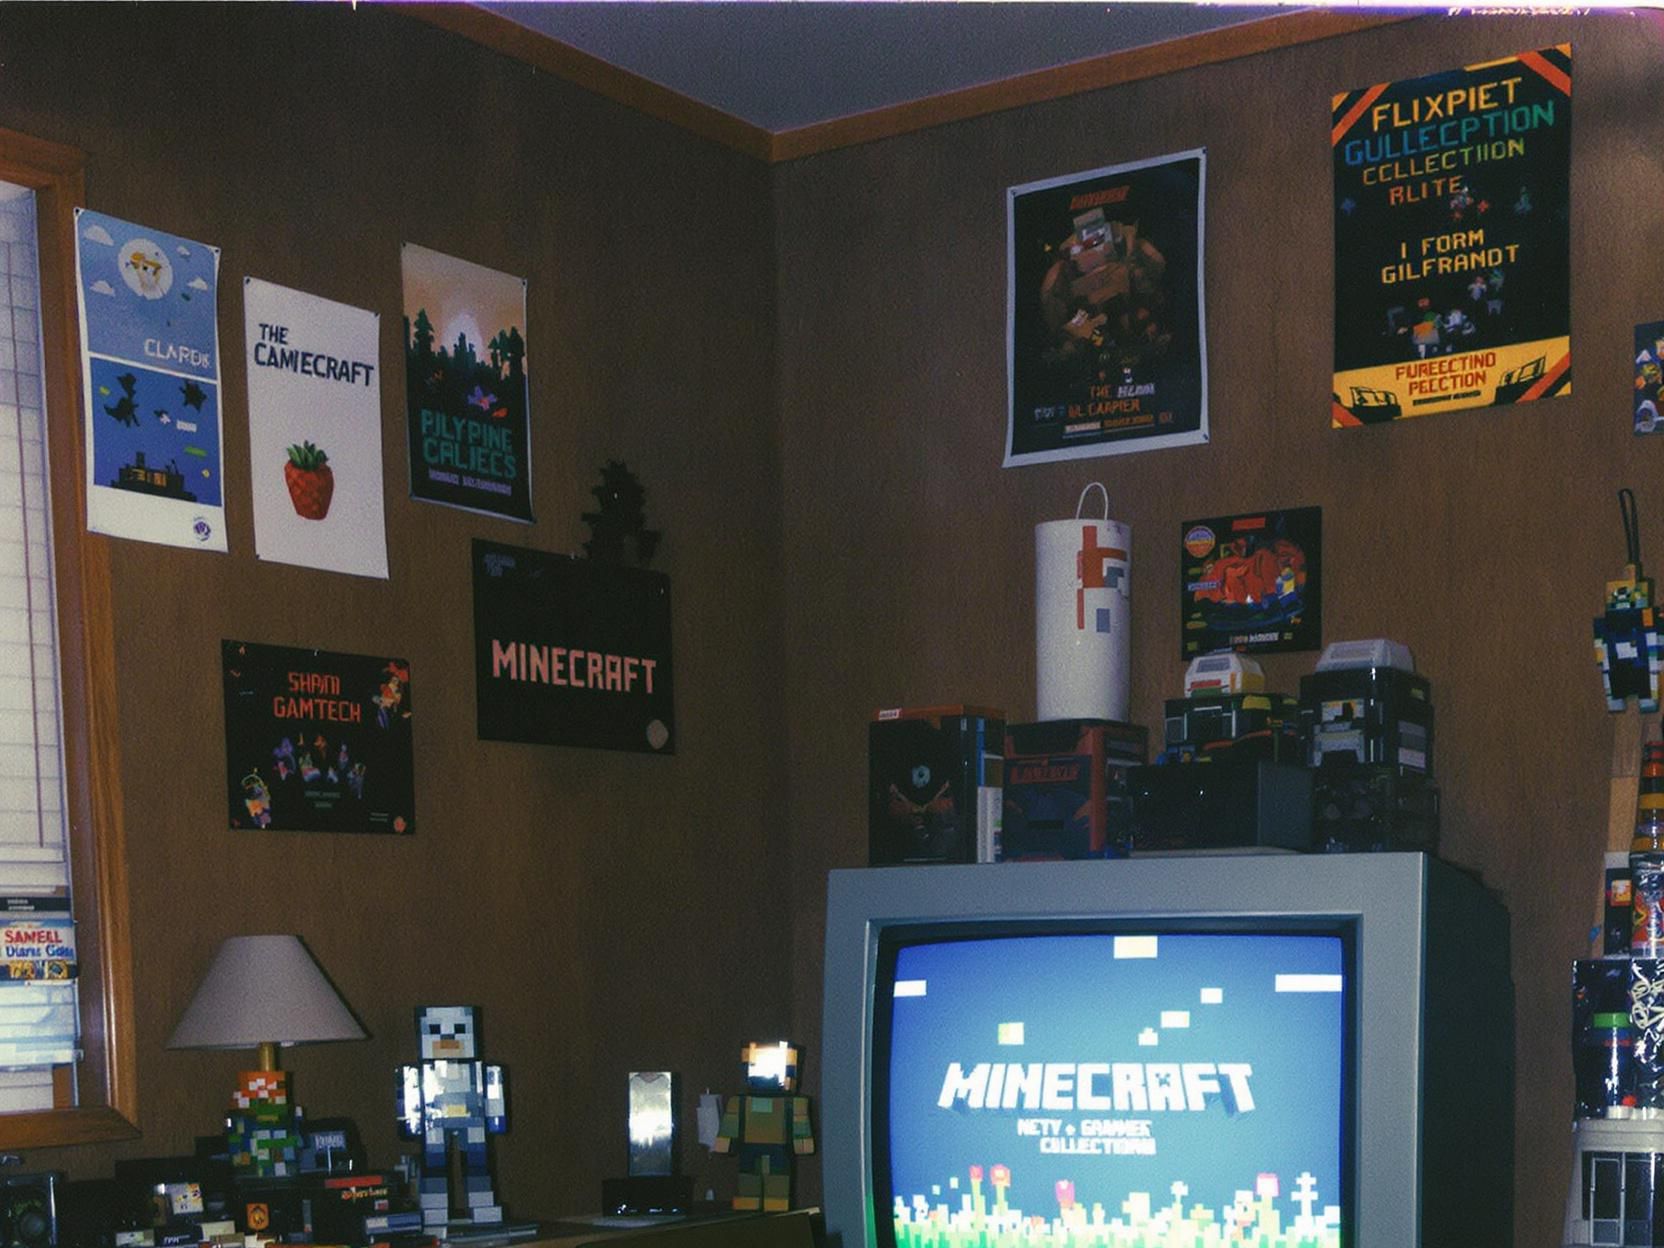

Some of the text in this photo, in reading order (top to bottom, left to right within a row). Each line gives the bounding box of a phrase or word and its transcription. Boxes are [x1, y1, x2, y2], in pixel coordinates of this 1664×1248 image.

[1372, 77, 1523, 132] FLIXPIET
[1421, 228, 1484, 256] FORM
[1381, 243, 1520, 284] GILFRANDT
[258, 323, 289, 345] THE
[492, 639, 657, 694] MINECRAFT
[273, 696, 362, 722] GAMTECH
[937, 1062, 1255, 1114] MINECRAFT
